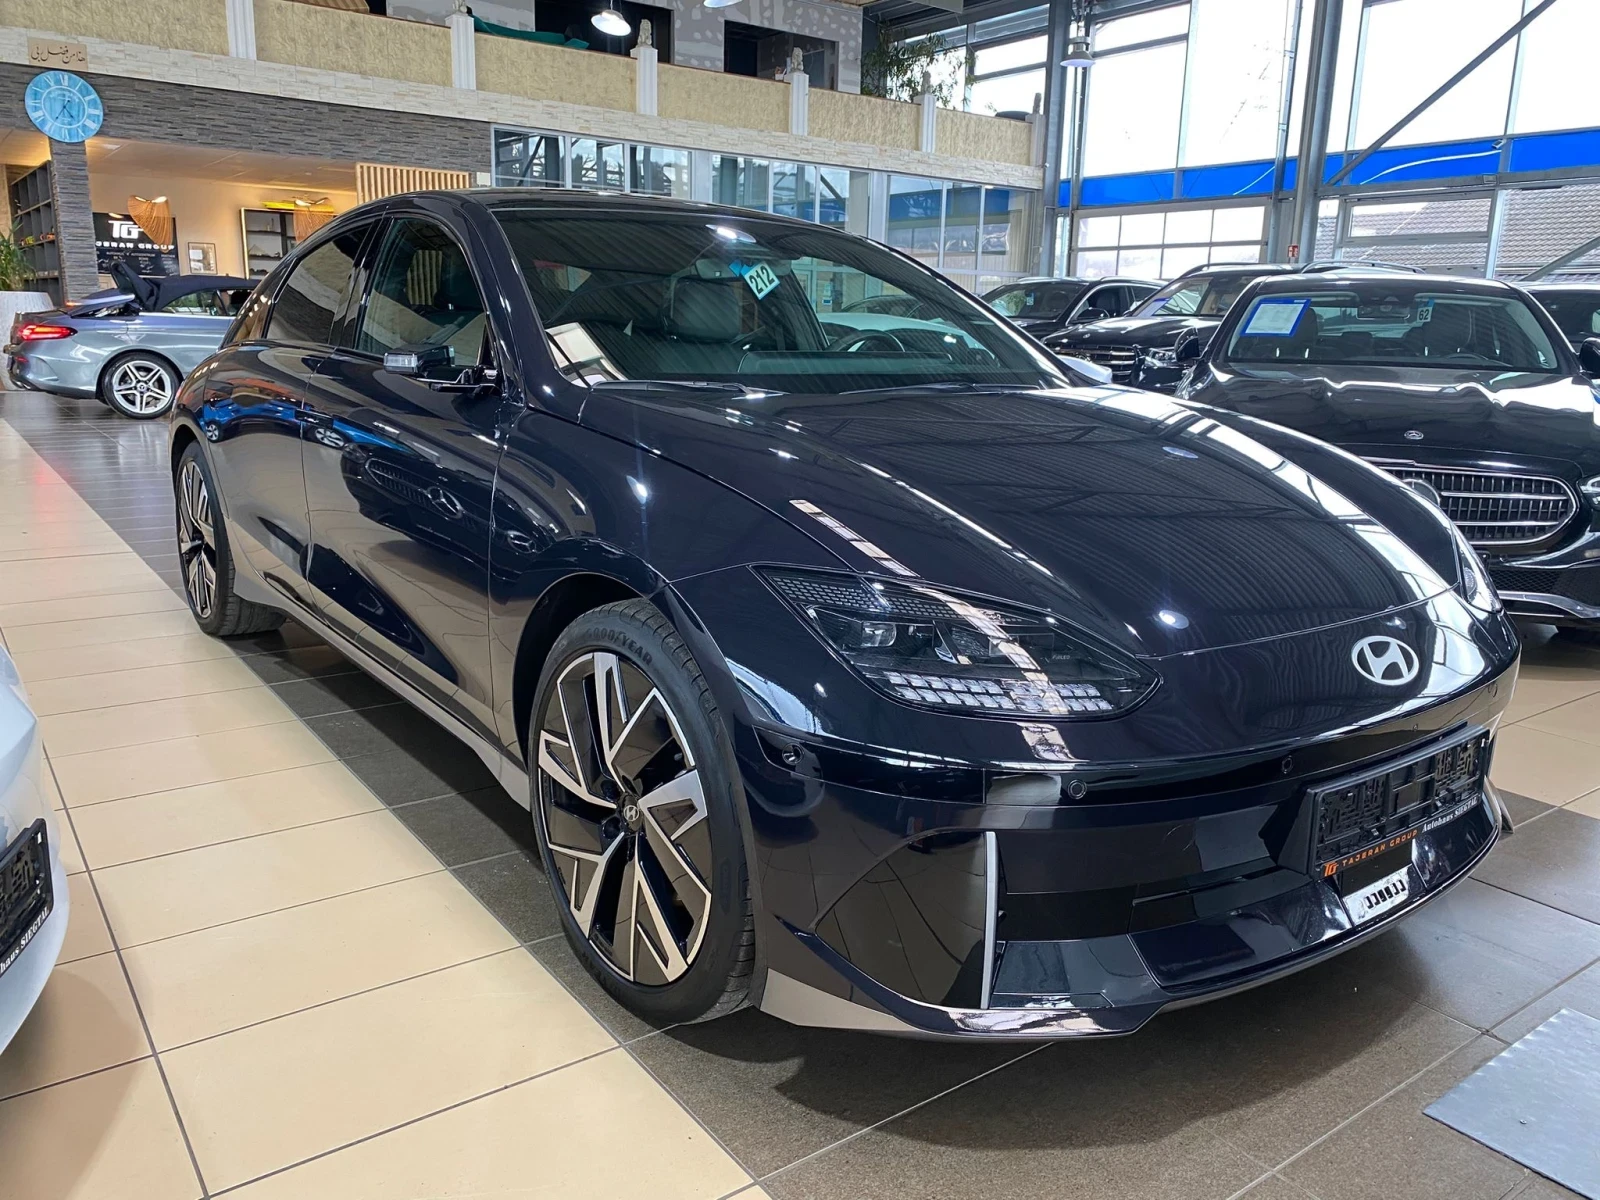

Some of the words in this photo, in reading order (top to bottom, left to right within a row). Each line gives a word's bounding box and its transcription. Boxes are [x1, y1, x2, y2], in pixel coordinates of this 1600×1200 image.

[138, 243, 175, 251] GROUP
[748, 265, 776, 295] 212
[1418, 309, 1430, 321] 62
[584, 626, 654, 665] GOODYEAR
[1422, 812, 1454, 834] Autohaus
[1454, 796, 1478, 818] SIEGTAL
[1342, 843, 1386, 868] TAJERAN
[1389, 829, 1418, 848] GROUP
[20, 906, 50, 949] SIEGTAL
